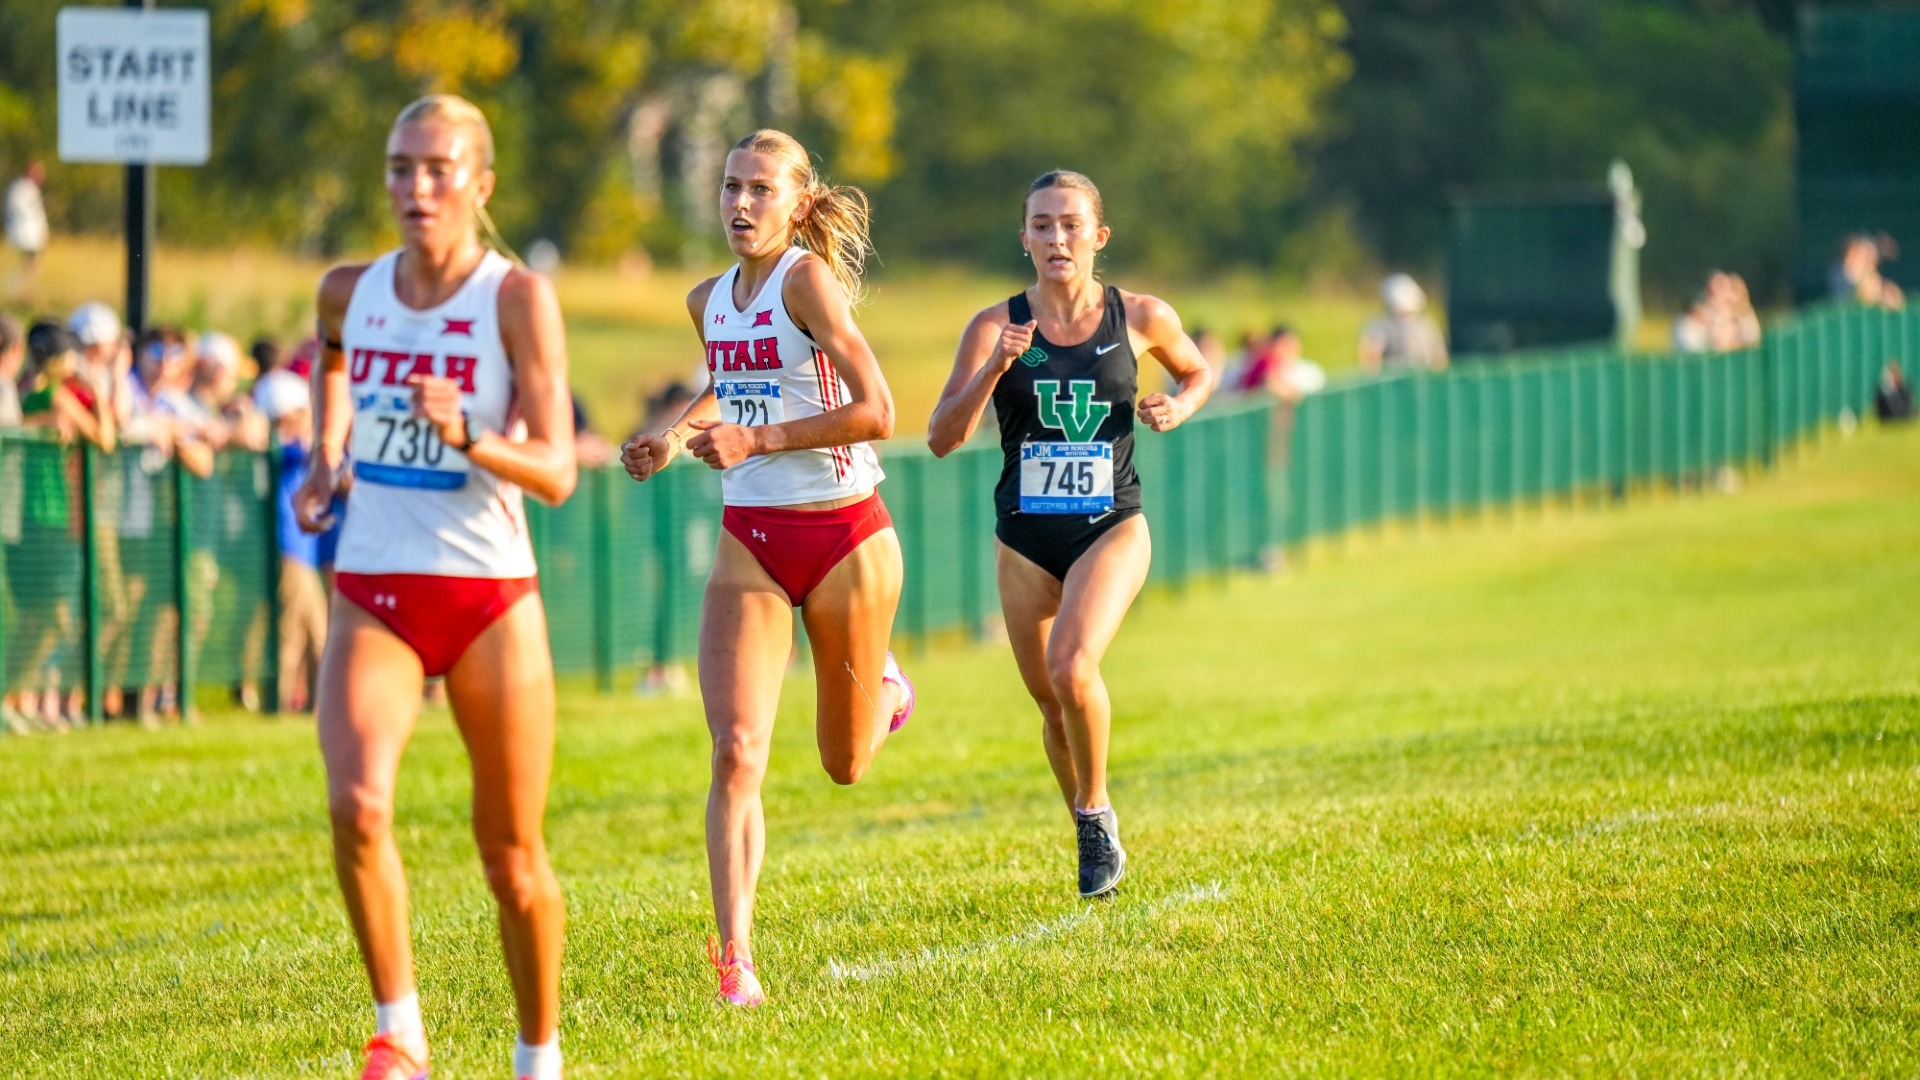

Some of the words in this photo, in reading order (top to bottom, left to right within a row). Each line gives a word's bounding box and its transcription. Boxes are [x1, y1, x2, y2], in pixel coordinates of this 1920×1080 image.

[67, 46, 195, 84] START
[87, 91, 178, 129] LINE
[351, 349, 478, 394] UTAH
[707, 337, 783, 372] UTAH
[730, 399, 769, 428] 721
[376, 416, 445, 467] 730
[1036, 445, 1052, 457] JM
[1040, 462, 1094, 495] 745
